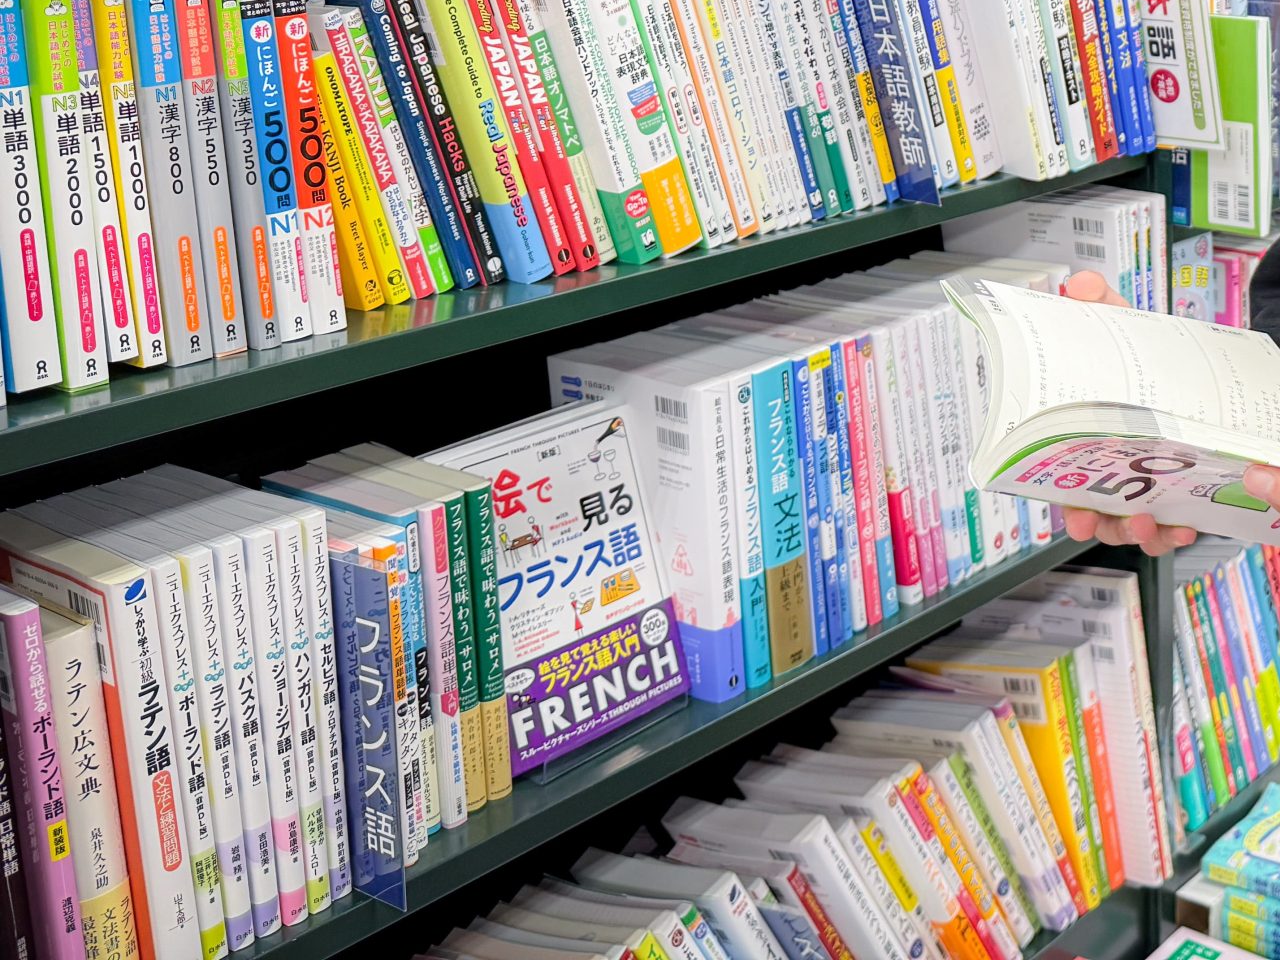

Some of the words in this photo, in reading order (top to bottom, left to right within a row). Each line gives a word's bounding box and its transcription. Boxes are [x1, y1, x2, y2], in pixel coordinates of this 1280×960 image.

[48, 21, 65, 92] 日本語能力試験
[108, 11, 125, 80] 日本語能力試験
[252, 24, 270, 40] 新
[289, 21, 306, 37] 新
[448, 4, 468, 56] Complete
[464, 56, 480, 88] Guide
[79, 72, 100, 89] N4
[113, 83, 135, 100] N5
[155, 86, 177, 102] N1
[191, 78, 215, 96] N2
[228, 80, 250, 97] N3
[256, 45, 279, 108] にほんご
[291, 42, 314, 104] にほんご
[355, 36, 394, 119] KANJI
[380, 14, 402, 64] Coming
[401, 81, 421, 117] Japan
[484, 35, 522, 107] JAPAN
[511, 33, 548, 105] JAPAN
[0, 90, 23, 108] N1
[52, 95, 78, 113] N3
[325, 66, 354, 137] ONOMATOPE
[409, 33, 446, 116] Japanese
[438, 116, 465, 172] Hacks
[479, 97, 505, 143] Real
[334, 175, 352, 211] Book
[491, 142, 529, 228] Japanese
[356, 242, 369, 271] Mayer
[767, 399, 790, 493] フランス語
[492, 468, 553, 519] 絵で
[579, 483, 634, 532] 見る
[773, 494, 803, 558] 文法
[498, 522, 643, 612] フランス語
[133, 604, 151, 656] しっかり学ぶ
[538, 622, 637, 676] 絵を見て覚える楽しい
[22, 624, 49, 714] ゼロから話せる
[511, 640, 680, 750] FRENCH
[540, 635, 641, 694] フランス語入門
[208, 685, 231, 751] ラテン語
[238, 674, 259, 736] バスク語
[271, 663, 293, 755] ジョージア語
[294, 653, 317, 747] ハンガリー語
[608, 693, 648, 719] THROUGH
[648, 675, 683, 698] PICTURES
[65, 658, 103, 802] ラテン広文典
[137, 683, 172, 776] ラテン語
[178, 695, 206, 793] ポーランド語
[355, 616, 396, 859] フランス語
[32, 716, 66, 821] ポーランド語
[53, 825, 66, 856] 新装版
[154, 773, 182, 869] 文法と練習問題
[236, 928, 254, 941] 白水社
[291, 904, 307, 916] 白水社
[208, 940, 226, 954] 白水社
